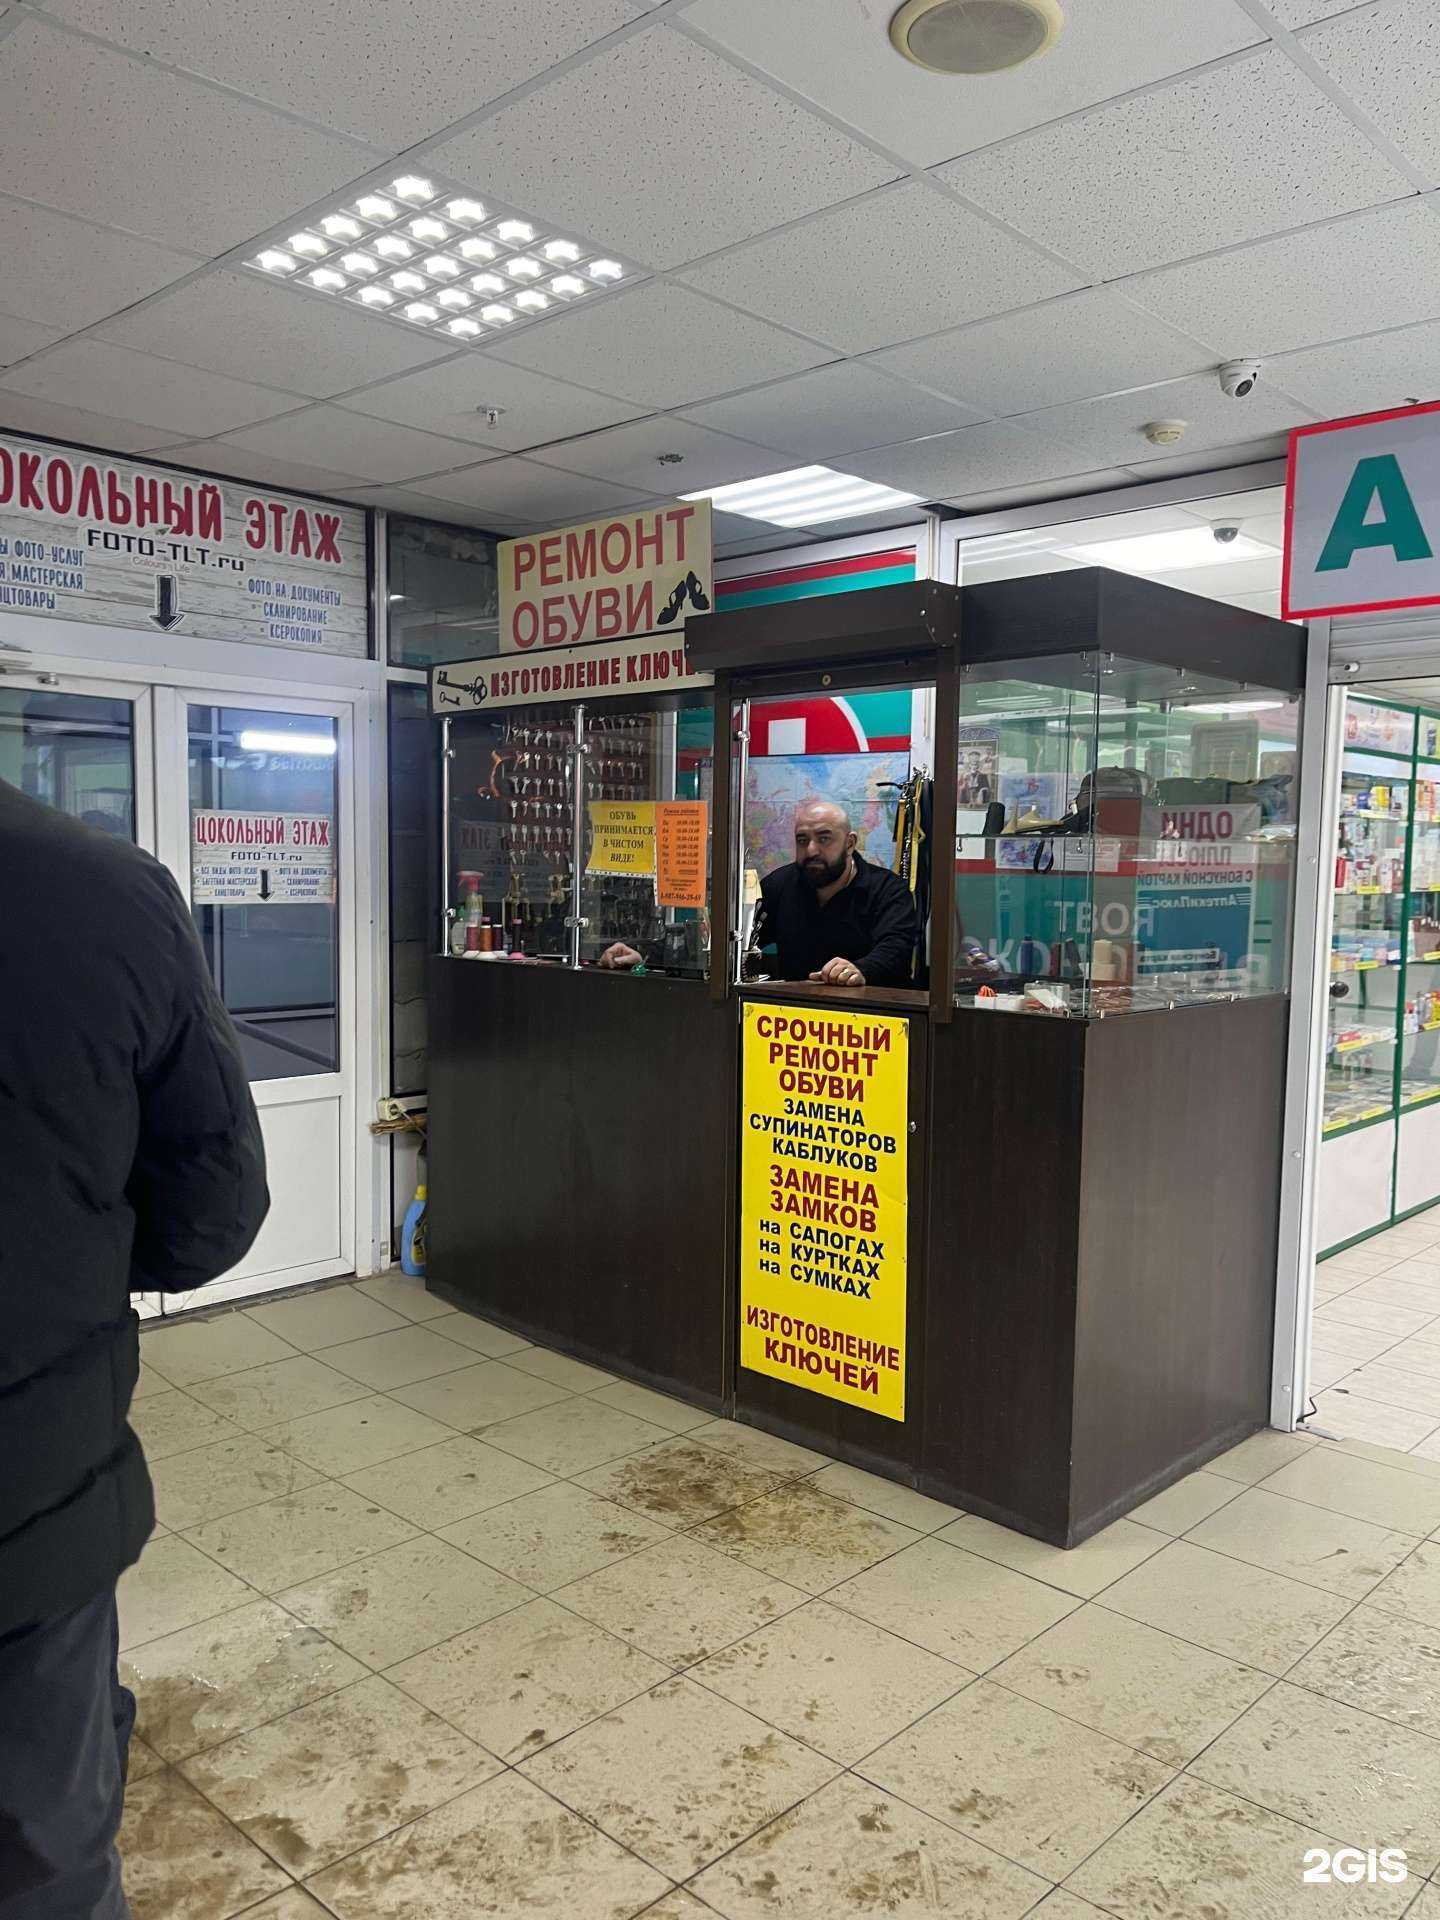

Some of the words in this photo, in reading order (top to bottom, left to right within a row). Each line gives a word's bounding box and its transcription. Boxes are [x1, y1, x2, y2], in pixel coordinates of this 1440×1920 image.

[87, 528, 244, 572] FOTO-TLT.ru
[246, 500, 341, 564] ЭТАЖ
[513, 507, 695, 591] РЕМОНТ
[15, 540, 84, 567] ФОТО-УСЛУГ
[12, 563, 83, 590] МАСТЕРСКАЯ
[248, 578, 271, 596] ФОТО
[275, 582, 287, 598] НА
[290, 585, 341, 606] ДОКУМЕНТЫ
[263, 602, 328, 625] СКАНИРОВАНИЕ
[512, 581, 653, 649] ОБУВИ
[270, 624, 322, 644] КСЕРОКОПИЯ
[490, 656, 621, 697] ИЗГОТОВЛЕНИЕ
[196, 816, 285, 845] ЦОКОЛЬНЫЙ
[293, 820, 329, 846] ЭТАЖ
[594, 824, 654, 835] ПРИНИМАЕТСЯ
[609, 811, 636, 820] ОБУВЬ
[610, 839, 644, 848] ЧИСТОМ
[757, 1015, 891, 1052] СРОЧНЫЙ
[769, 1042, 878, 1077] РЕМОНТ
[779, 1069, 864, 1102] ОБУВИ
[783, 1098, 865, 1127] ЗАМЕНА
[750, 1113, 897, 1154] СУПИНАТОРОВ
[772, 1138, 878, 1172] КАБЛУКОВ
[769, 1164, 879, 1208] ЗАМЕНА
[770, 1190, 877, 1233] ЗАМКОВ
[759, 1219, 780, 1235] на
[789, 1222, 885, 1260] САПОГАХ
[759, 1239, 780, 1255] на
[791, 1243, 880, 1281] КУРТКАХ
[759, 1258, 780, 1275] на
[790, 1264, 871, 1300] СУМКАХ
[746, 1304, 900, 1371] ИЗГОТОВЛЕНИЕ
[764, 1337, 879, 1395] КЛЮЧЕЙ
